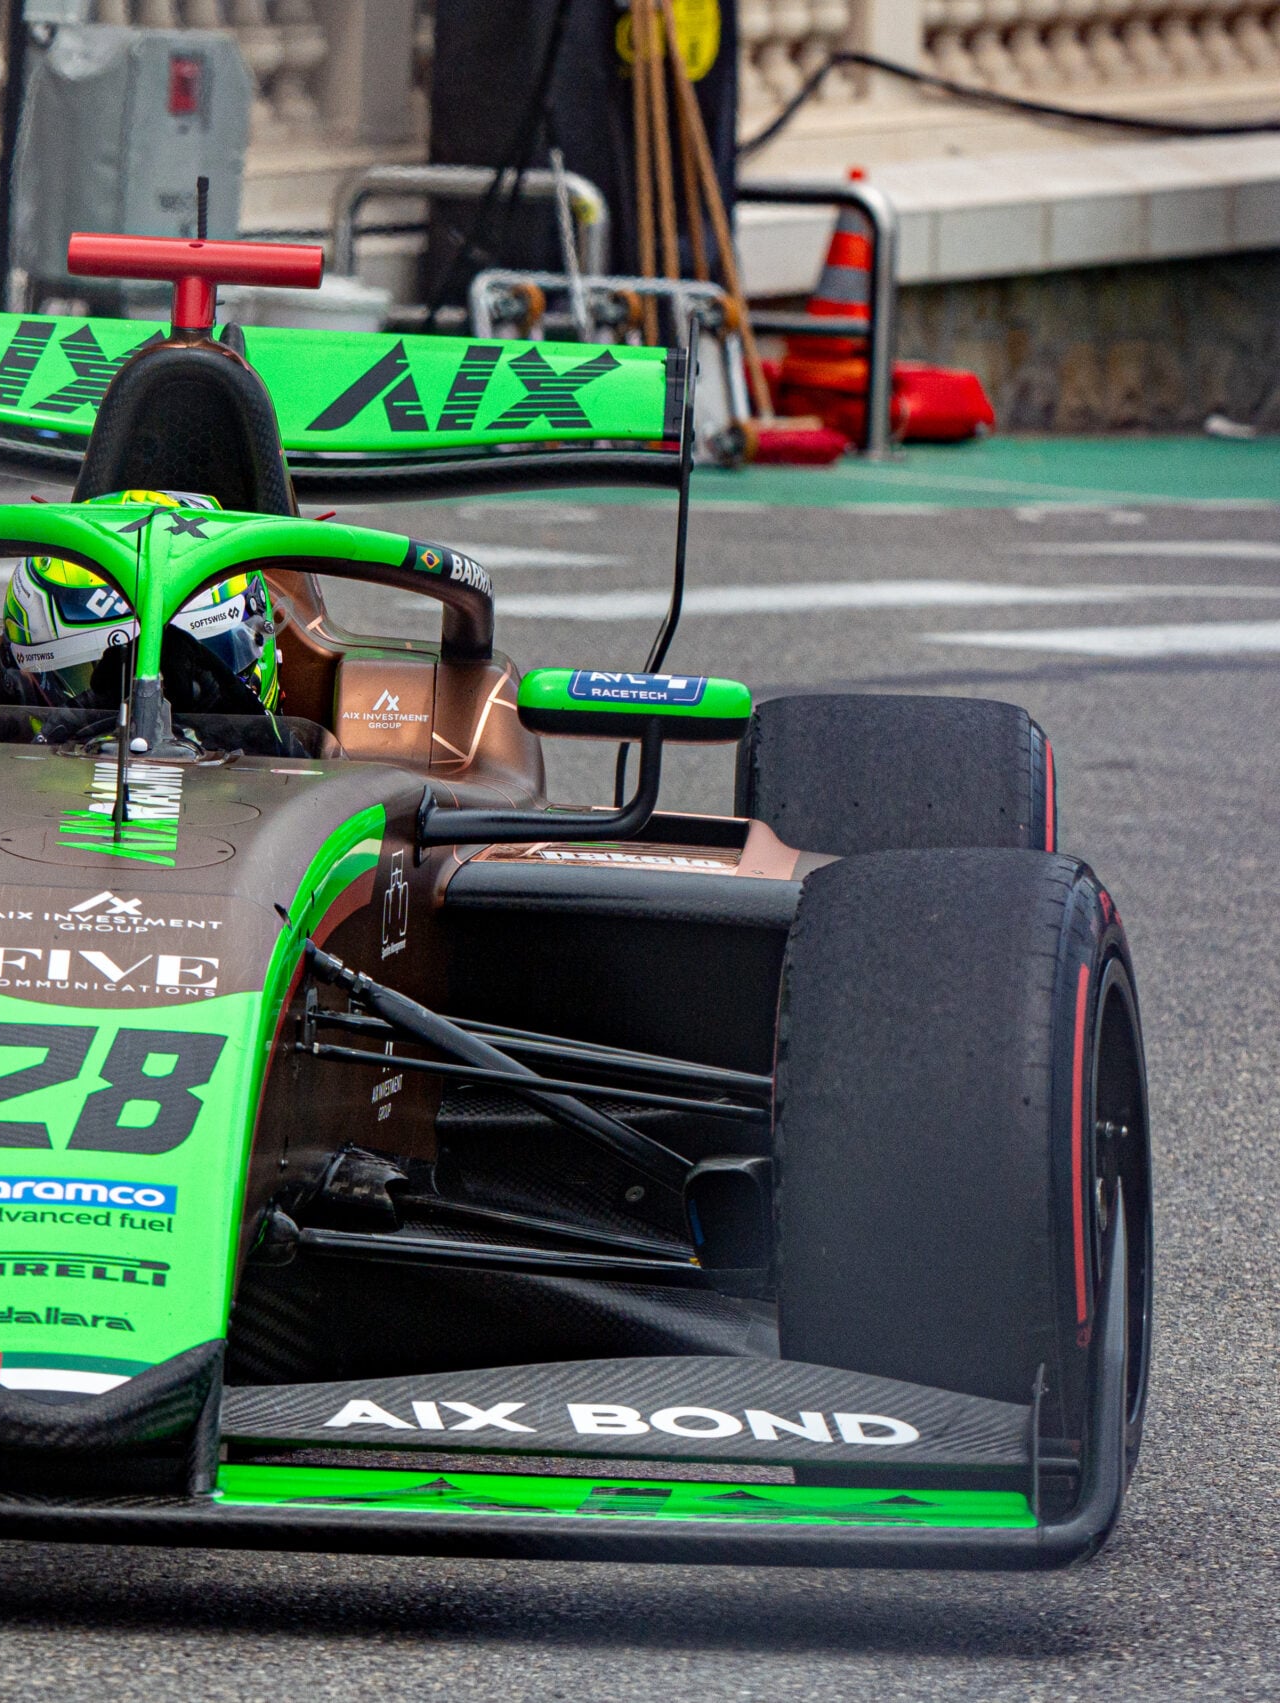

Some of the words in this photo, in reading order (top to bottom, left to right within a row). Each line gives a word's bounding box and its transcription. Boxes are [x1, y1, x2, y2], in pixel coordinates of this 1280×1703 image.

[304, 339, 622, 432] AIX
[190, 612, 227, 630] SOFTSWISS
[591, 688, 667, 700] RACETECH
[342, 711, 360, 720] AIX
[363, 712, 429, 722] INVESTMENT
[44, 912, 223, 930] INVESTMENT
[59, 923, 149, 933] GROUP
[120, 1212, 174, 1233] fuel
[322, 1400, 537, 1433] AIX
[567, 1403, 920, 1446] BOND
